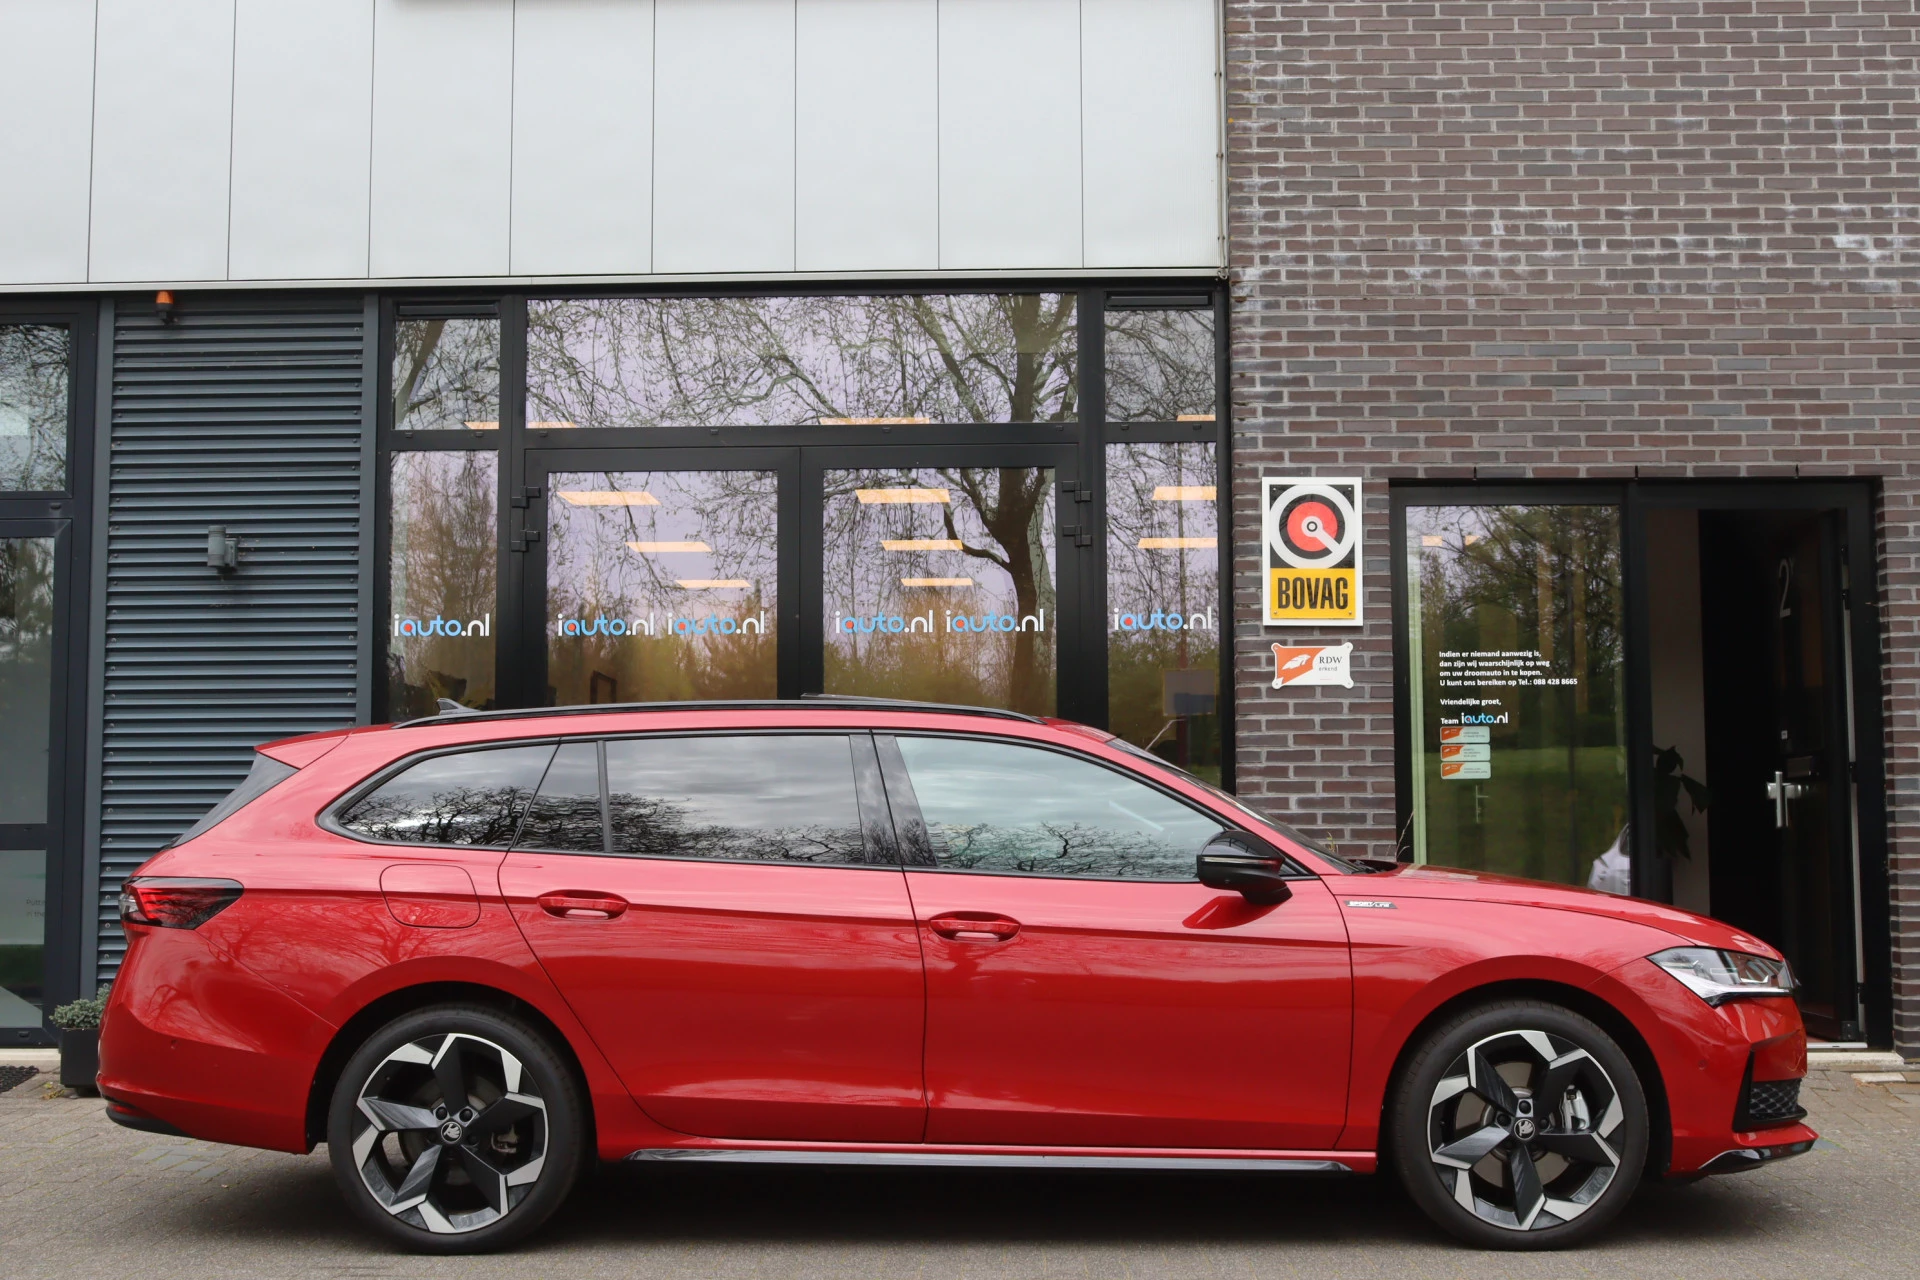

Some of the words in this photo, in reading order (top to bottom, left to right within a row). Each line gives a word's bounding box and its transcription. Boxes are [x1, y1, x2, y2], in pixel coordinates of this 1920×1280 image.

[1277, 577, 1348, 609] BOVAG
[394, 613, 490, 636] iauto.nl
[557, 612, 654, 636] iauto.nl
[668, 611, 764, 635] iauto.nl
[835, 609, 934, 633] iauto.nl
[946, 608, 1044, 632] iauto.nl
[1114, 606, 1211, 630] iauto.nl
[1319, 656, 1343, 664] RDW
[1502, 650, 1532, 658] aanwezig
[1520, 669, 1542, 677] kopen.
[1461, 712, 1508, 724] iauto.nl
